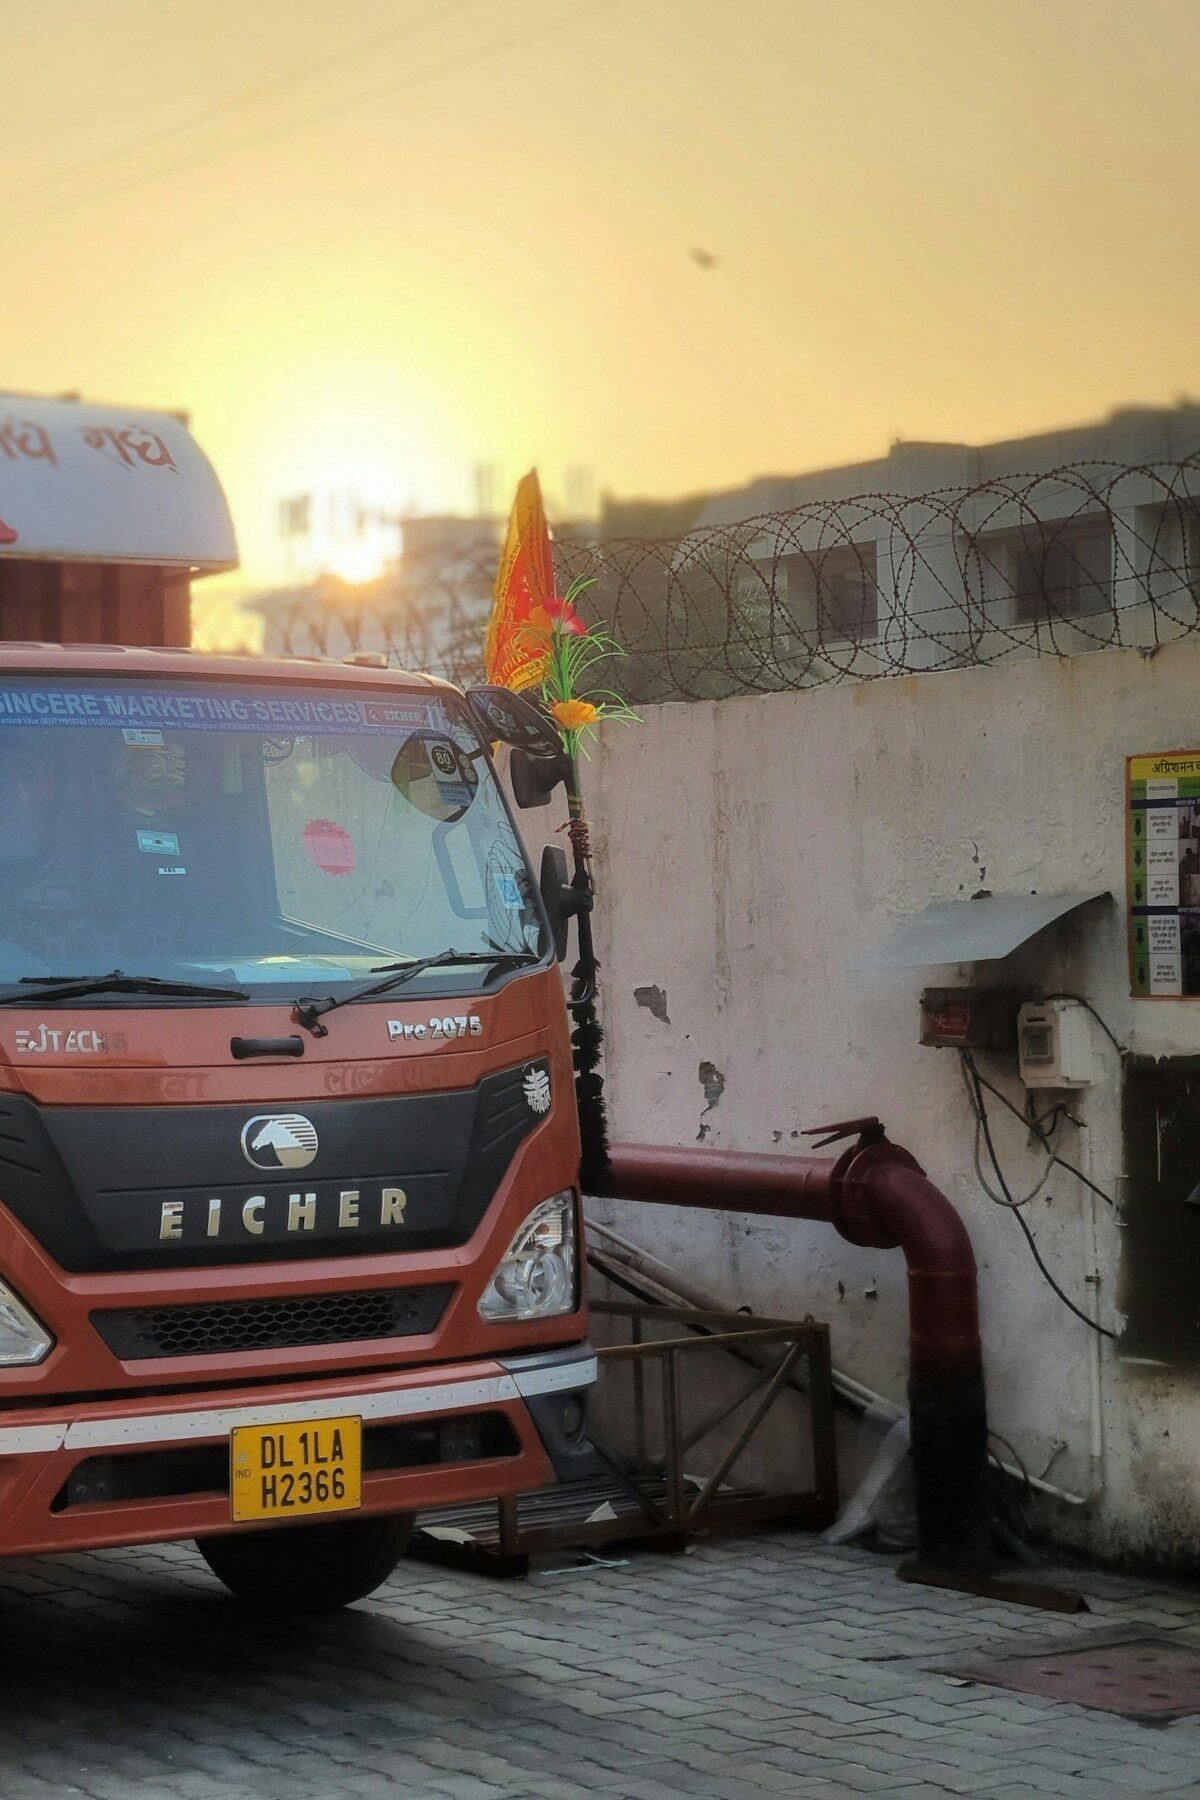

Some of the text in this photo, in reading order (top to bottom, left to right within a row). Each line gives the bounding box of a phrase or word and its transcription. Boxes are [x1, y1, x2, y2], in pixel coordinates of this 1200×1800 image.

[103, 694, 249, 721] MARKETING
[251, 699, 361, 724] SERVICES
[383, 710, 422, 723] EICHER
[435, 752, 451, 765] 80
[429, 1016, 483, 1039] 2075
[159, 1187, 407, 1241] EICHER
[260, 1428, 344, 1469] DL1LA
[235, 1469, 251, 1479] IND
[261, 1467, 345, 1509] H2366
